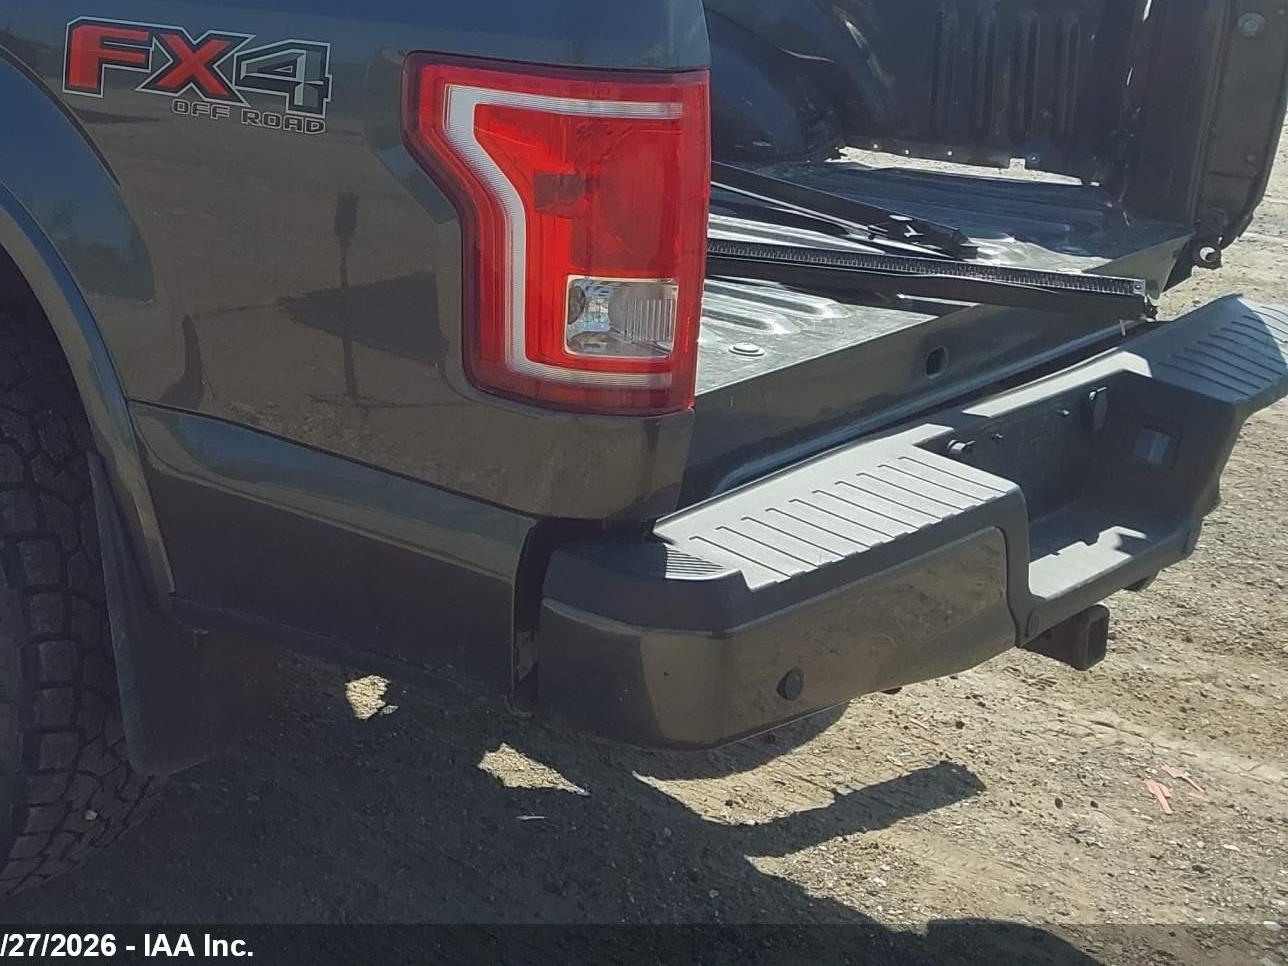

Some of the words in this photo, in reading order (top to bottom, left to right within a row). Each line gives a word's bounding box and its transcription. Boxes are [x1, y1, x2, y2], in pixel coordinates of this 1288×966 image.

[63, 16, 332, 118] FX4
[172, 99, 231, 121] OFF
[241, 110, 326, 135] ROAD
